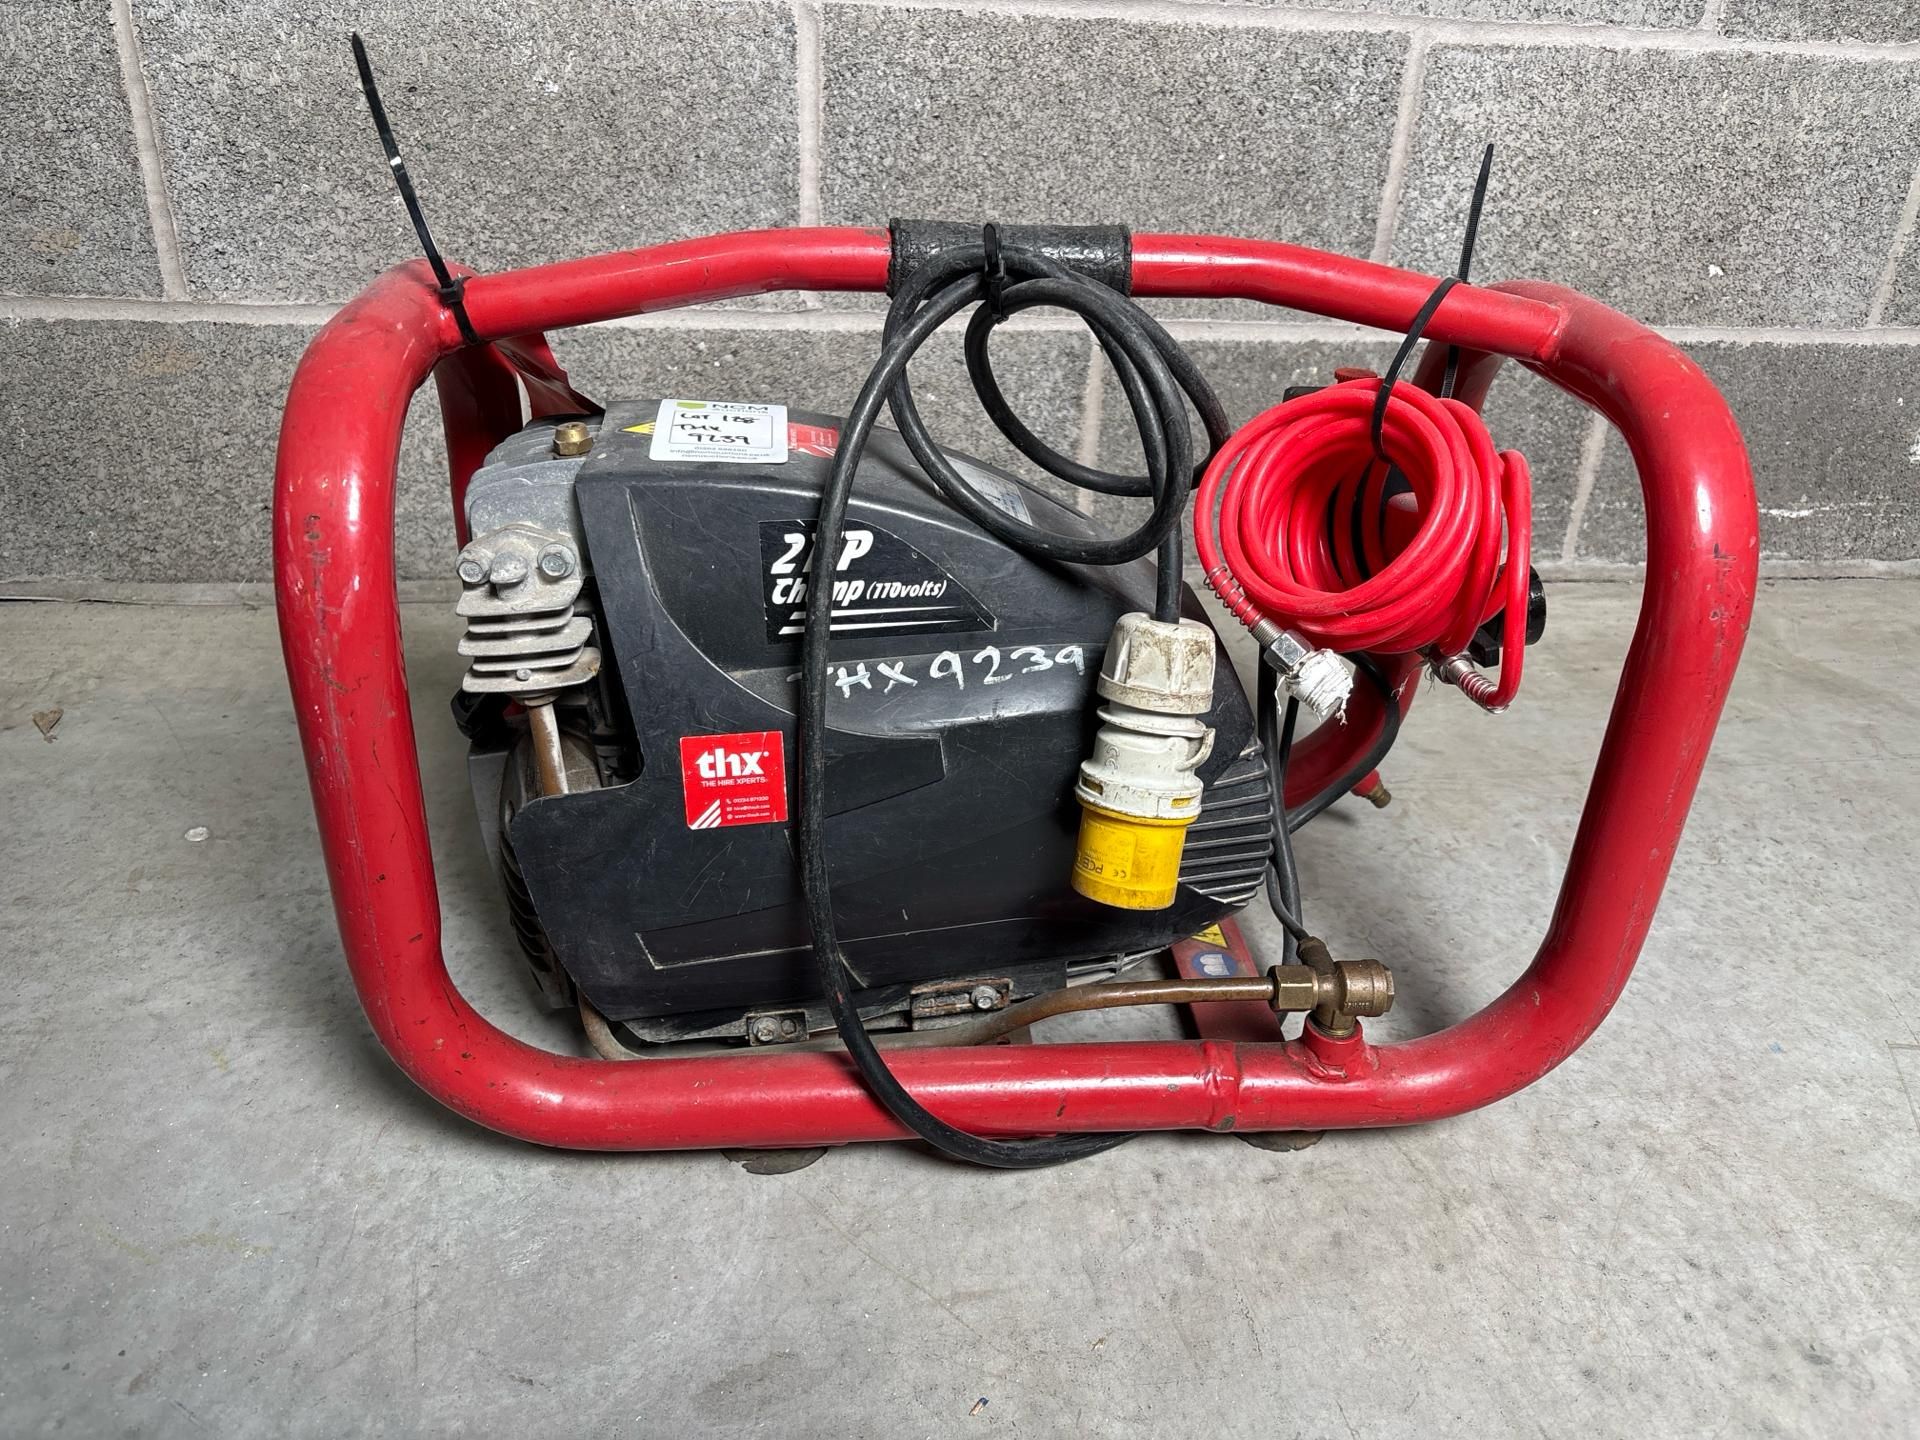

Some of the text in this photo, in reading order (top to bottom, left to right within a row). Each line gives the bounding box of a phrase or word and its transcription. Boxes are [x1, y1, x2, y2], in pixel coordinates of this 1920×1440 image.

[712, 403, 768, 412] NCM
[687, 432, 751, 445] 9239
[770, 530, 874, 574] 2P
[771, 577, 947, 606] Chmp (110volts)
[930, 645, 1086, 690] 9239
[695, 748, 765, 779] thx
[701, 780, 717, 788] THE
[717, 778, 735, 787] HIRE
